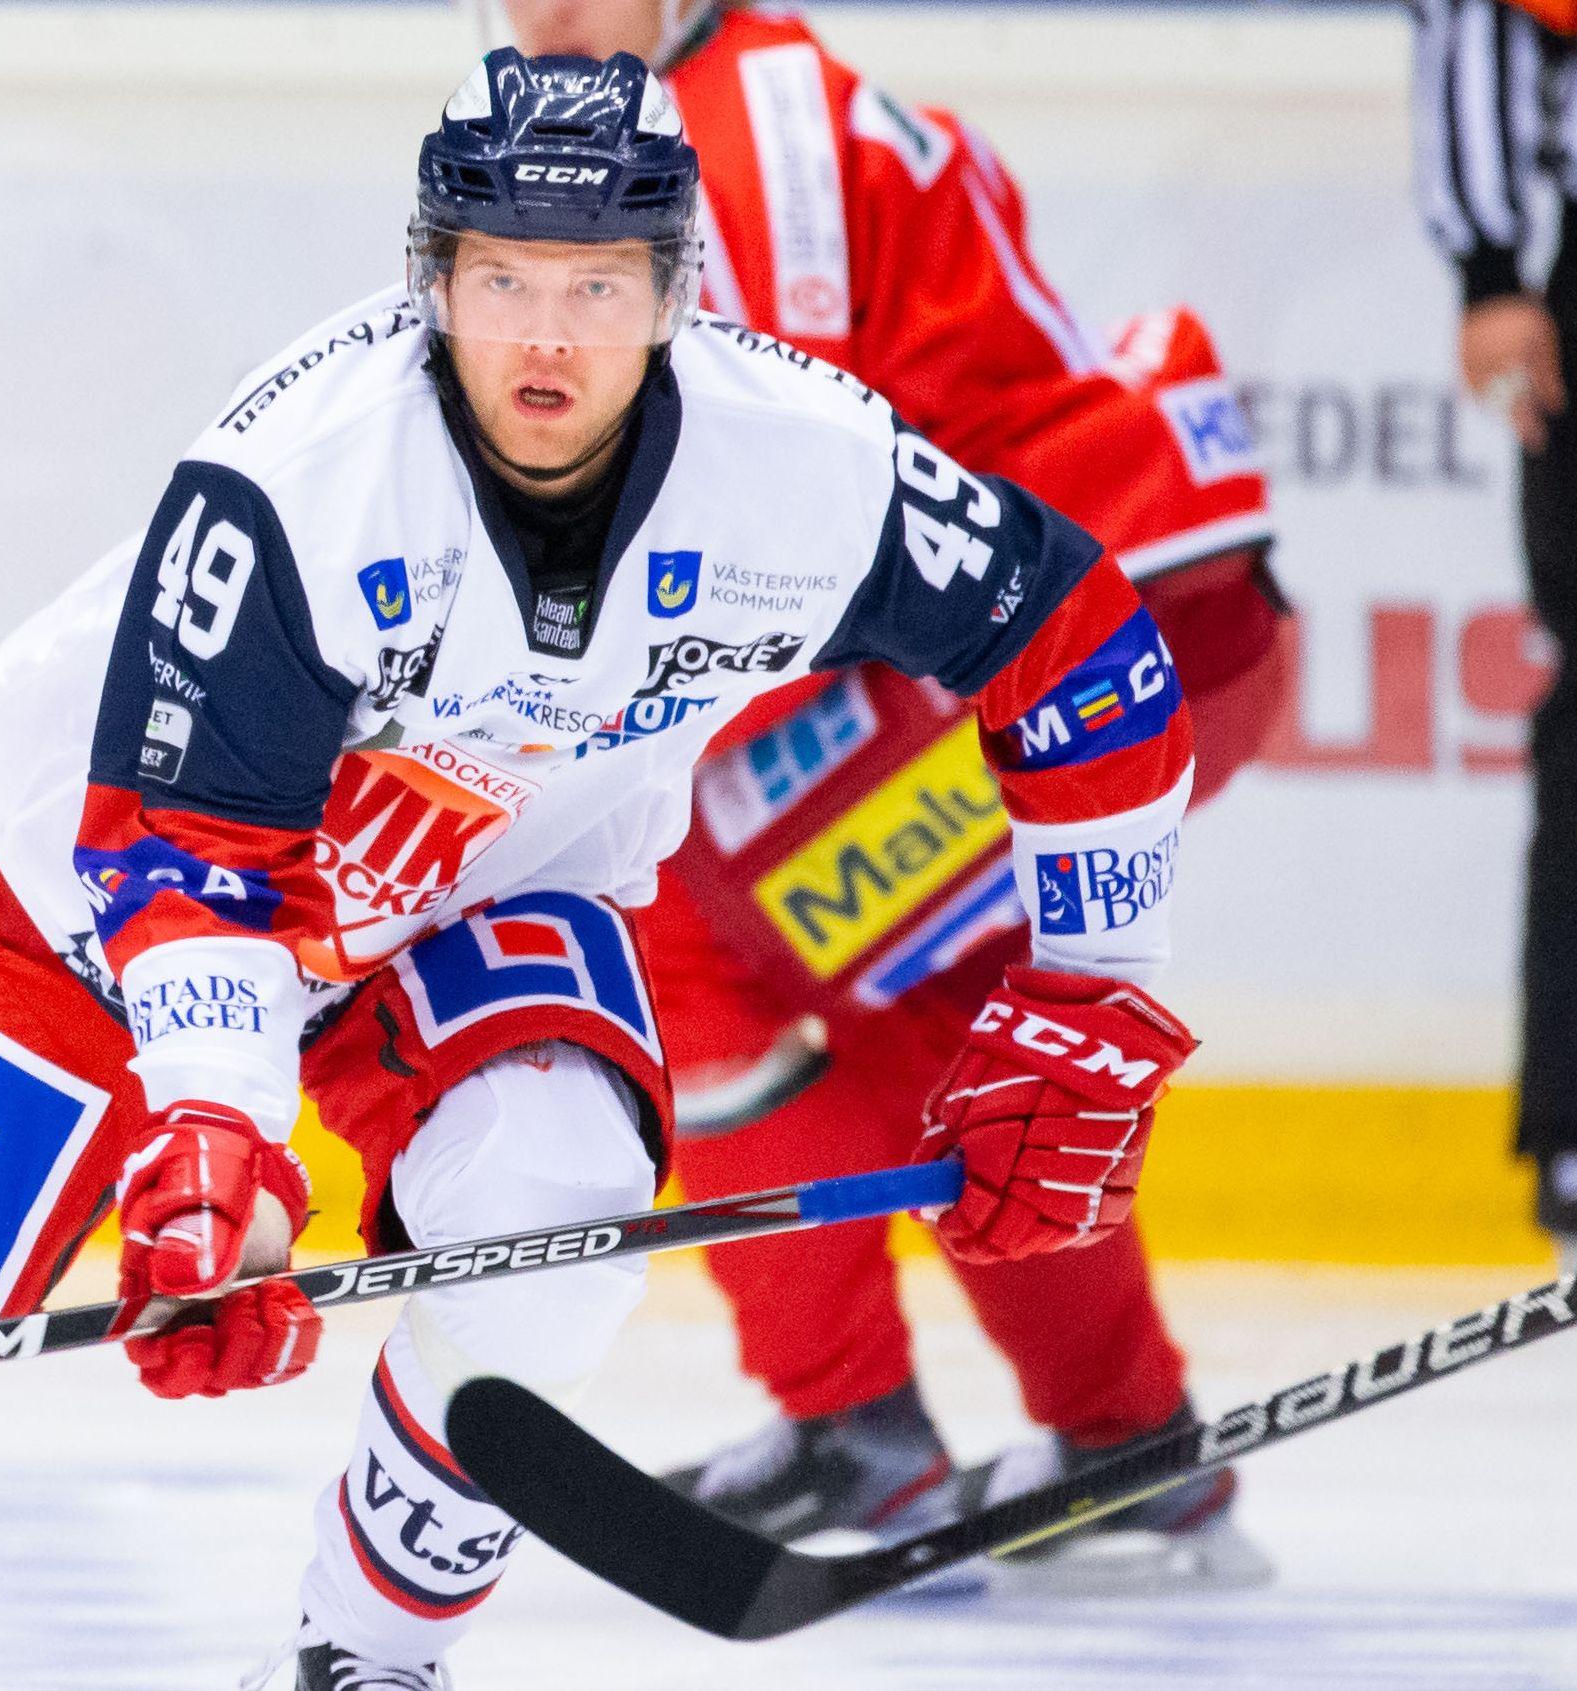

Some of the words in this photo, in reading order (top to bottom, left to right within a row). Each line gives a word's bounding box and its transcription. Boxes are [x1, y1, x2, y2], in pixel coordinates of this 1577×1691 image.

[514, 163, 609, 186] CCM
[895, 431, 1003, 594] 49
[151, 492, 255, 661] 49
[536, 593, 575, 625] klean
[710, 585, 804, 611] KOMMUN
[712, 562, 839, 591] VÄSTERVIKS
[533, 615, 580, 650] kanteen
[148, 640, 206, 707] ERVIK
[321, 752, 505, 888] VIK
[970, 1001, 1160, 1089] CCM
[312, 1226, 623, 1304] JETSPEED
[1194, 1272, 1577, 1464] BAUER
